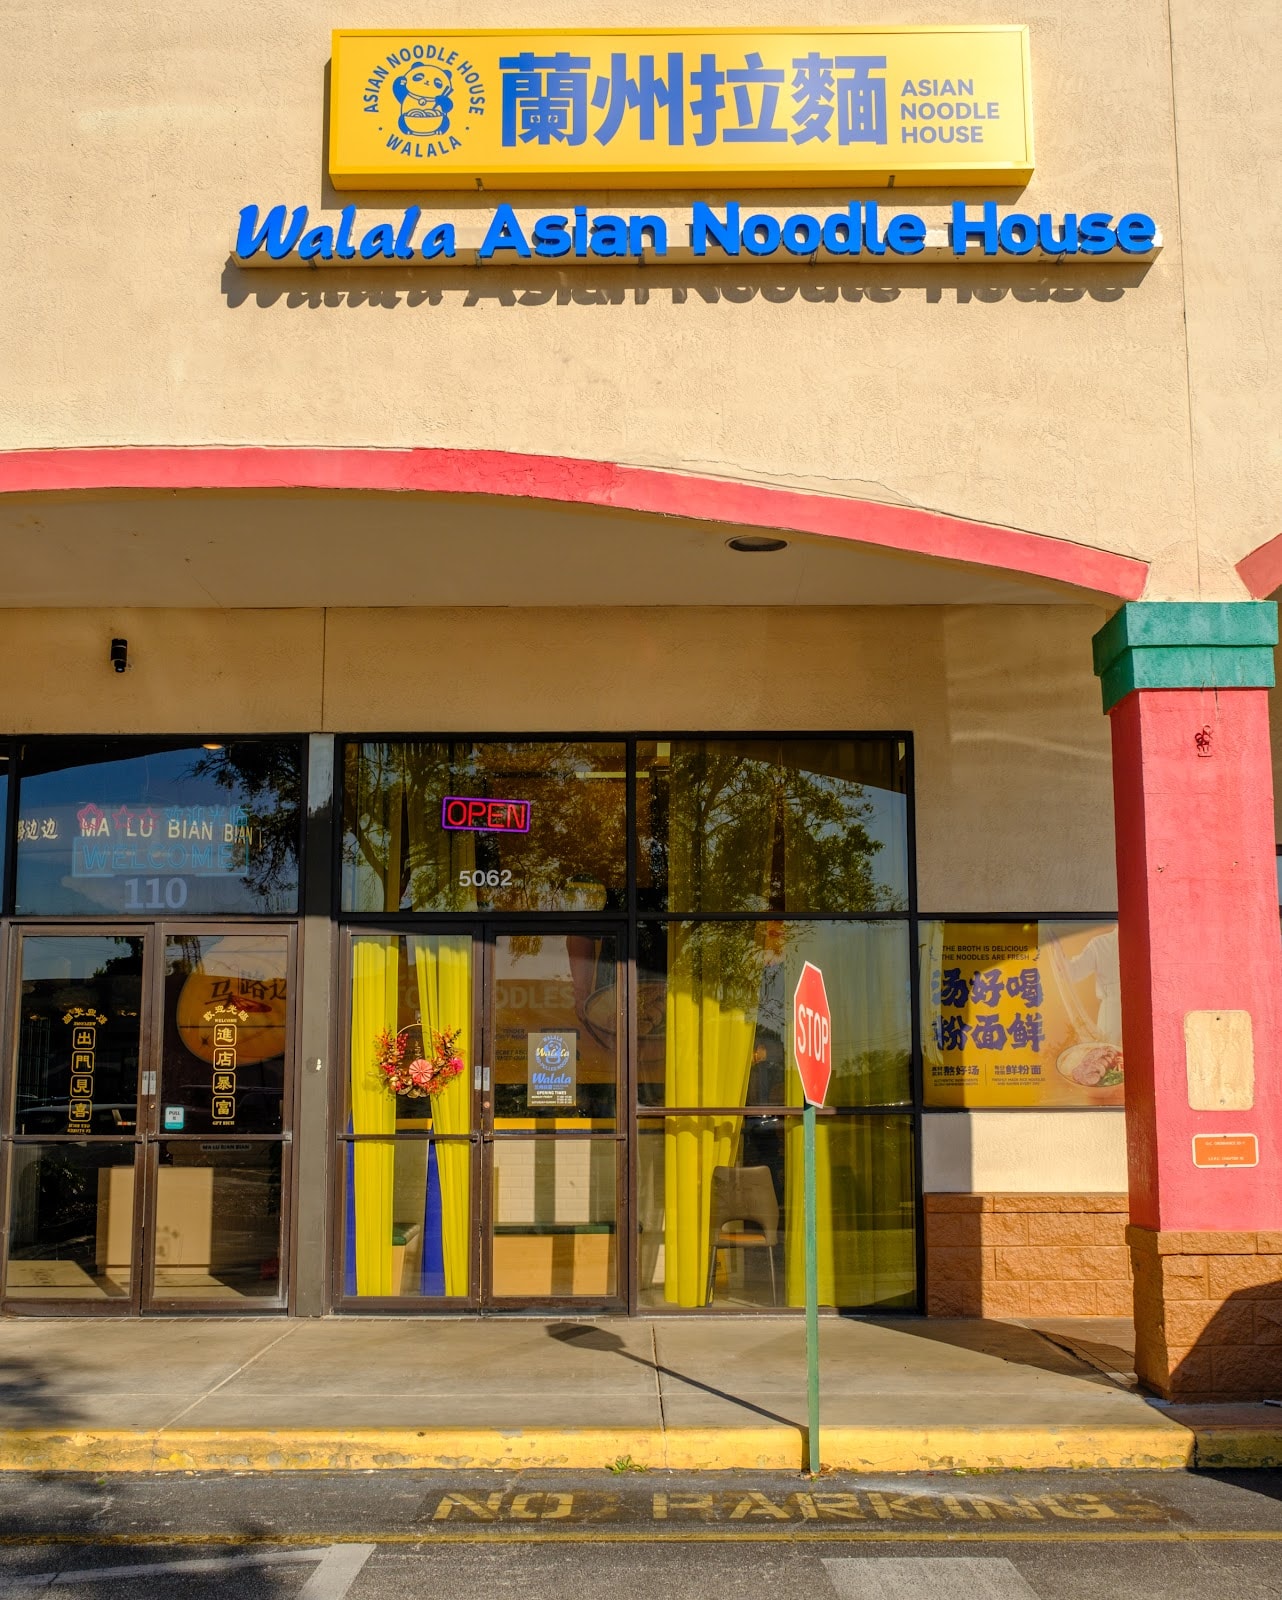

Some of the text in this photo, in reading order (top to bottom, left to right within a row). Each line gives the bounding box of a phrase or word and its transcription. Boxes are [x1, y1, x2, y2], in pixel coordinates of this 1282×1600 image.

[363, 44, 486, 116] ASIAN NOODLE HOUSE
[901, 79, 974, 96] ASIAN
[499, 52, 887, 146] 蘭州拉麵
[901, 102, 1000, 120] NOODLE
[386, 133, 462, 158] WALALA
[901, 126, 984, 143] HOUSE
[236, 201, 1157, 259] Walala Asian Noodle House
[447, 800, 527, 829] OPEN
[82, 818, 253, 846] MA LU BIAN BIAN
[82, 843, 235, 870] WELCOME
[459, 869, 513, 887] 5062
[125, 877, 188, 909] 110
[931, 968, 1044, 1008] 汤好喝
[797, 1003, 830, 1064] STOP
[932, 1013, 1045, 1052] 粉面鲜
[214, 1028, 234, 1117] 進店暴富
[532, 1072, 571, 1084] Walala
[433, 1492, 1117, 1519] NO PARKING
